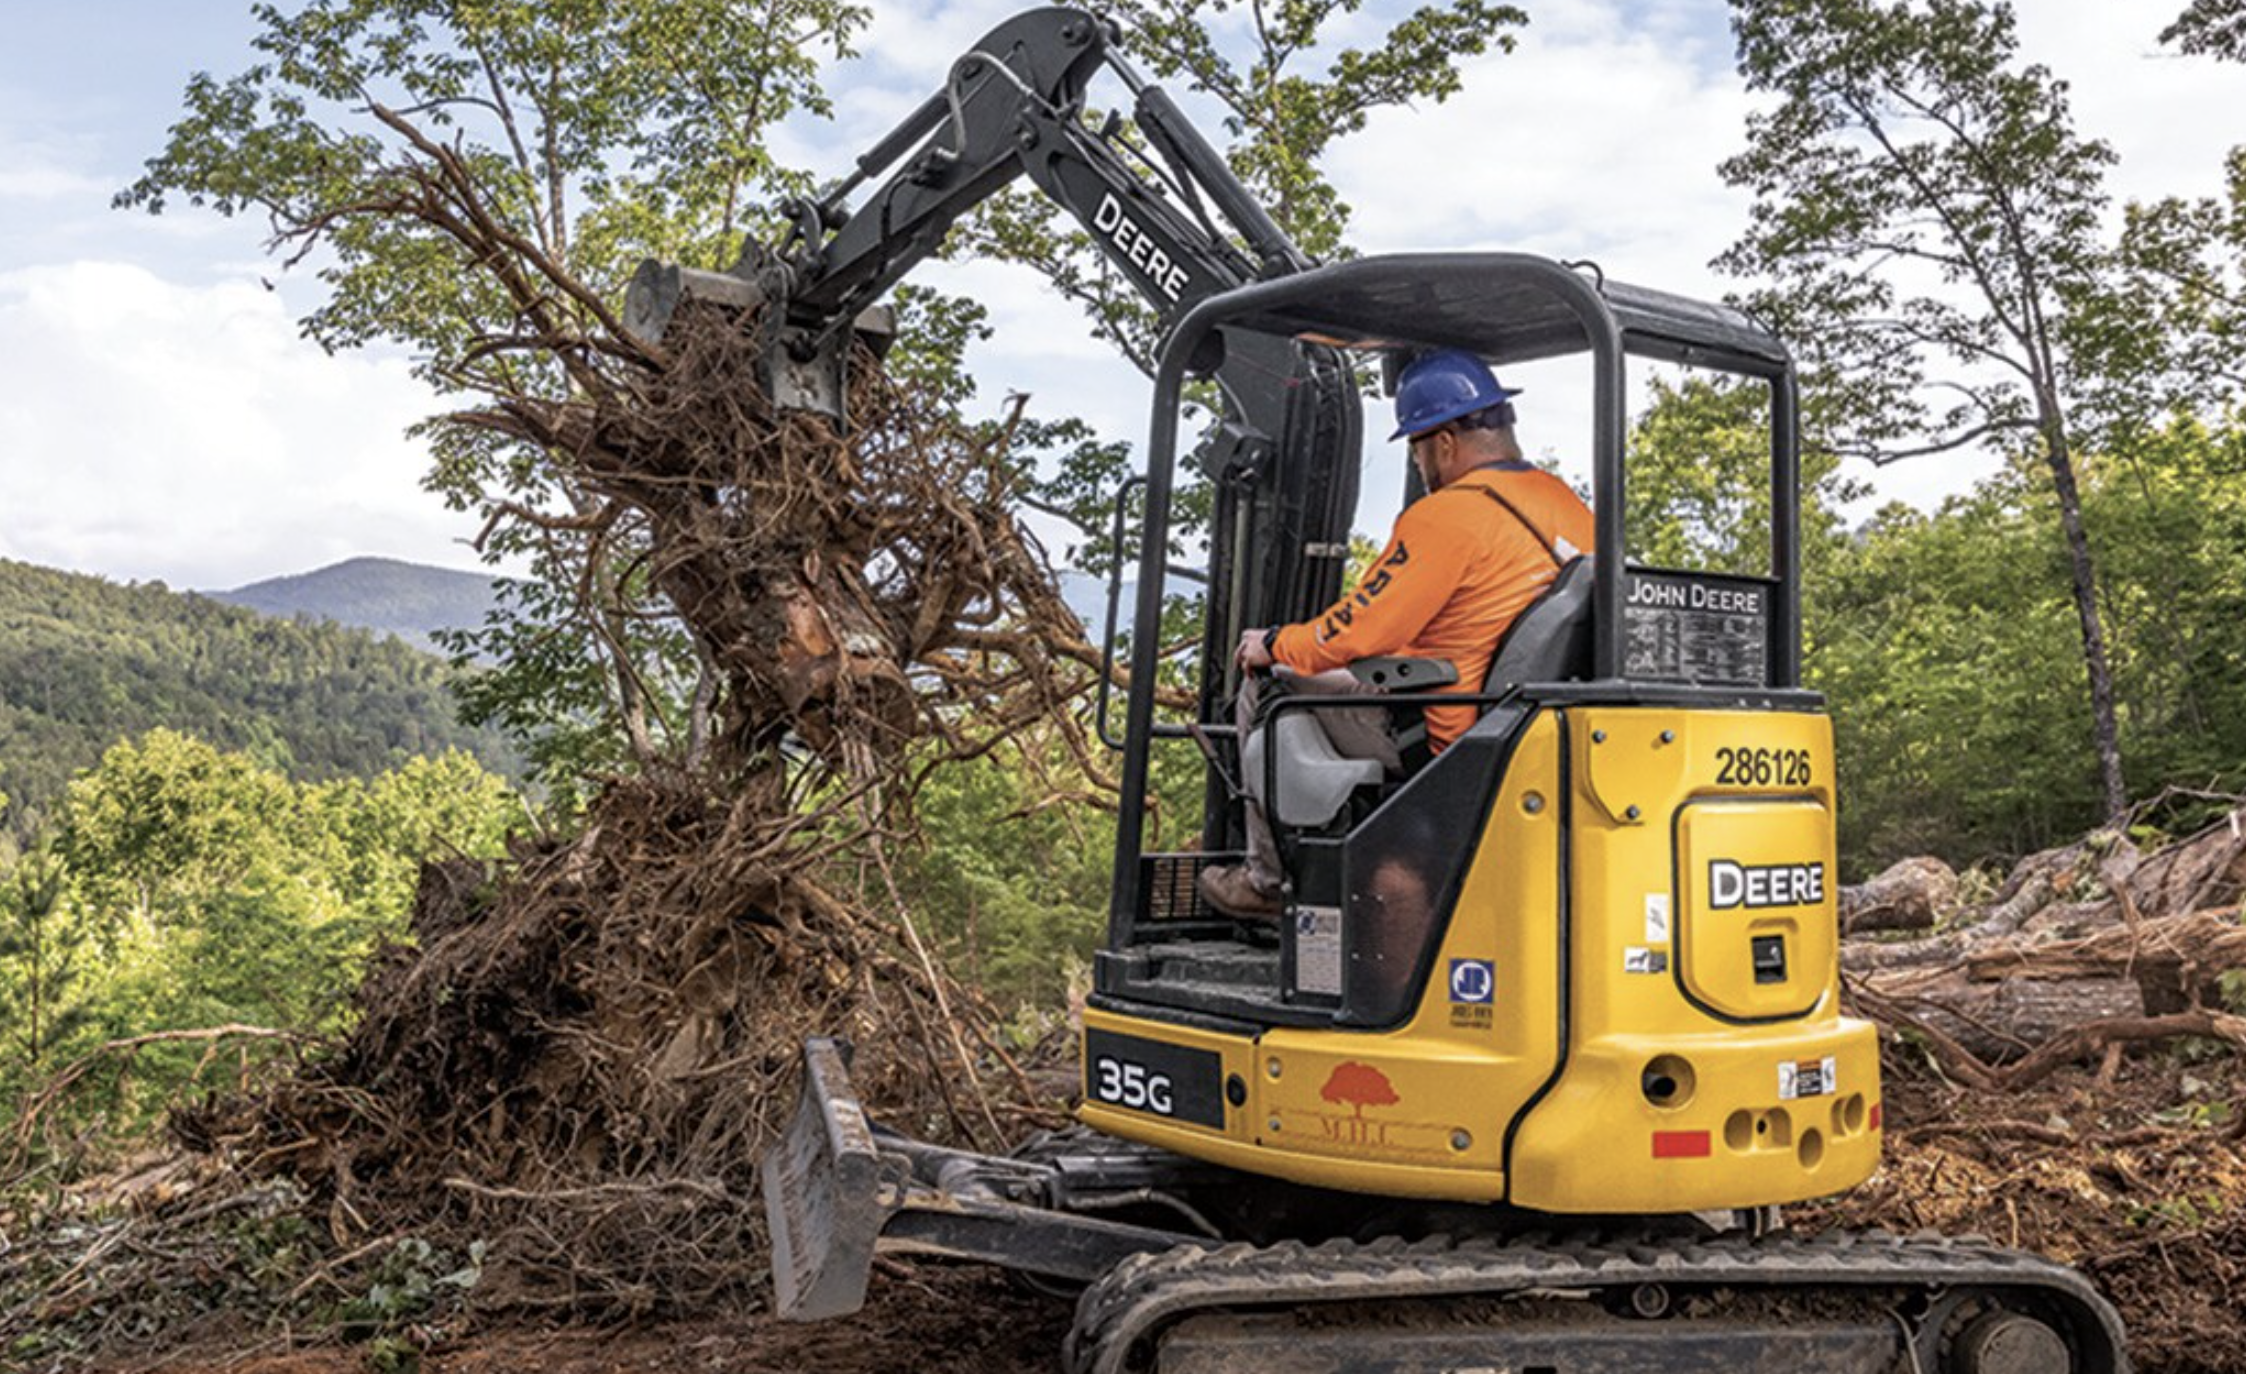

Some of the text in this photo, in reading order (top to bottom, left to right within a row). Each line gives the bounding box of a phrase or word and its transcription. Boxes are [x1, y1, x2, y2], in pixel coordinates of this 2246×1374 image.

[1093, 191, 1190, 302] DEERE
[1322, 540, 1409, 642] ARIAT
[1627, 577, 1760, 613] JOHN DEERE
[1715, 747, 1811, 786] 286126
[1710, 860, 1823, 908] DEERE
[1098, 1058, 1172, 1114] 35G
